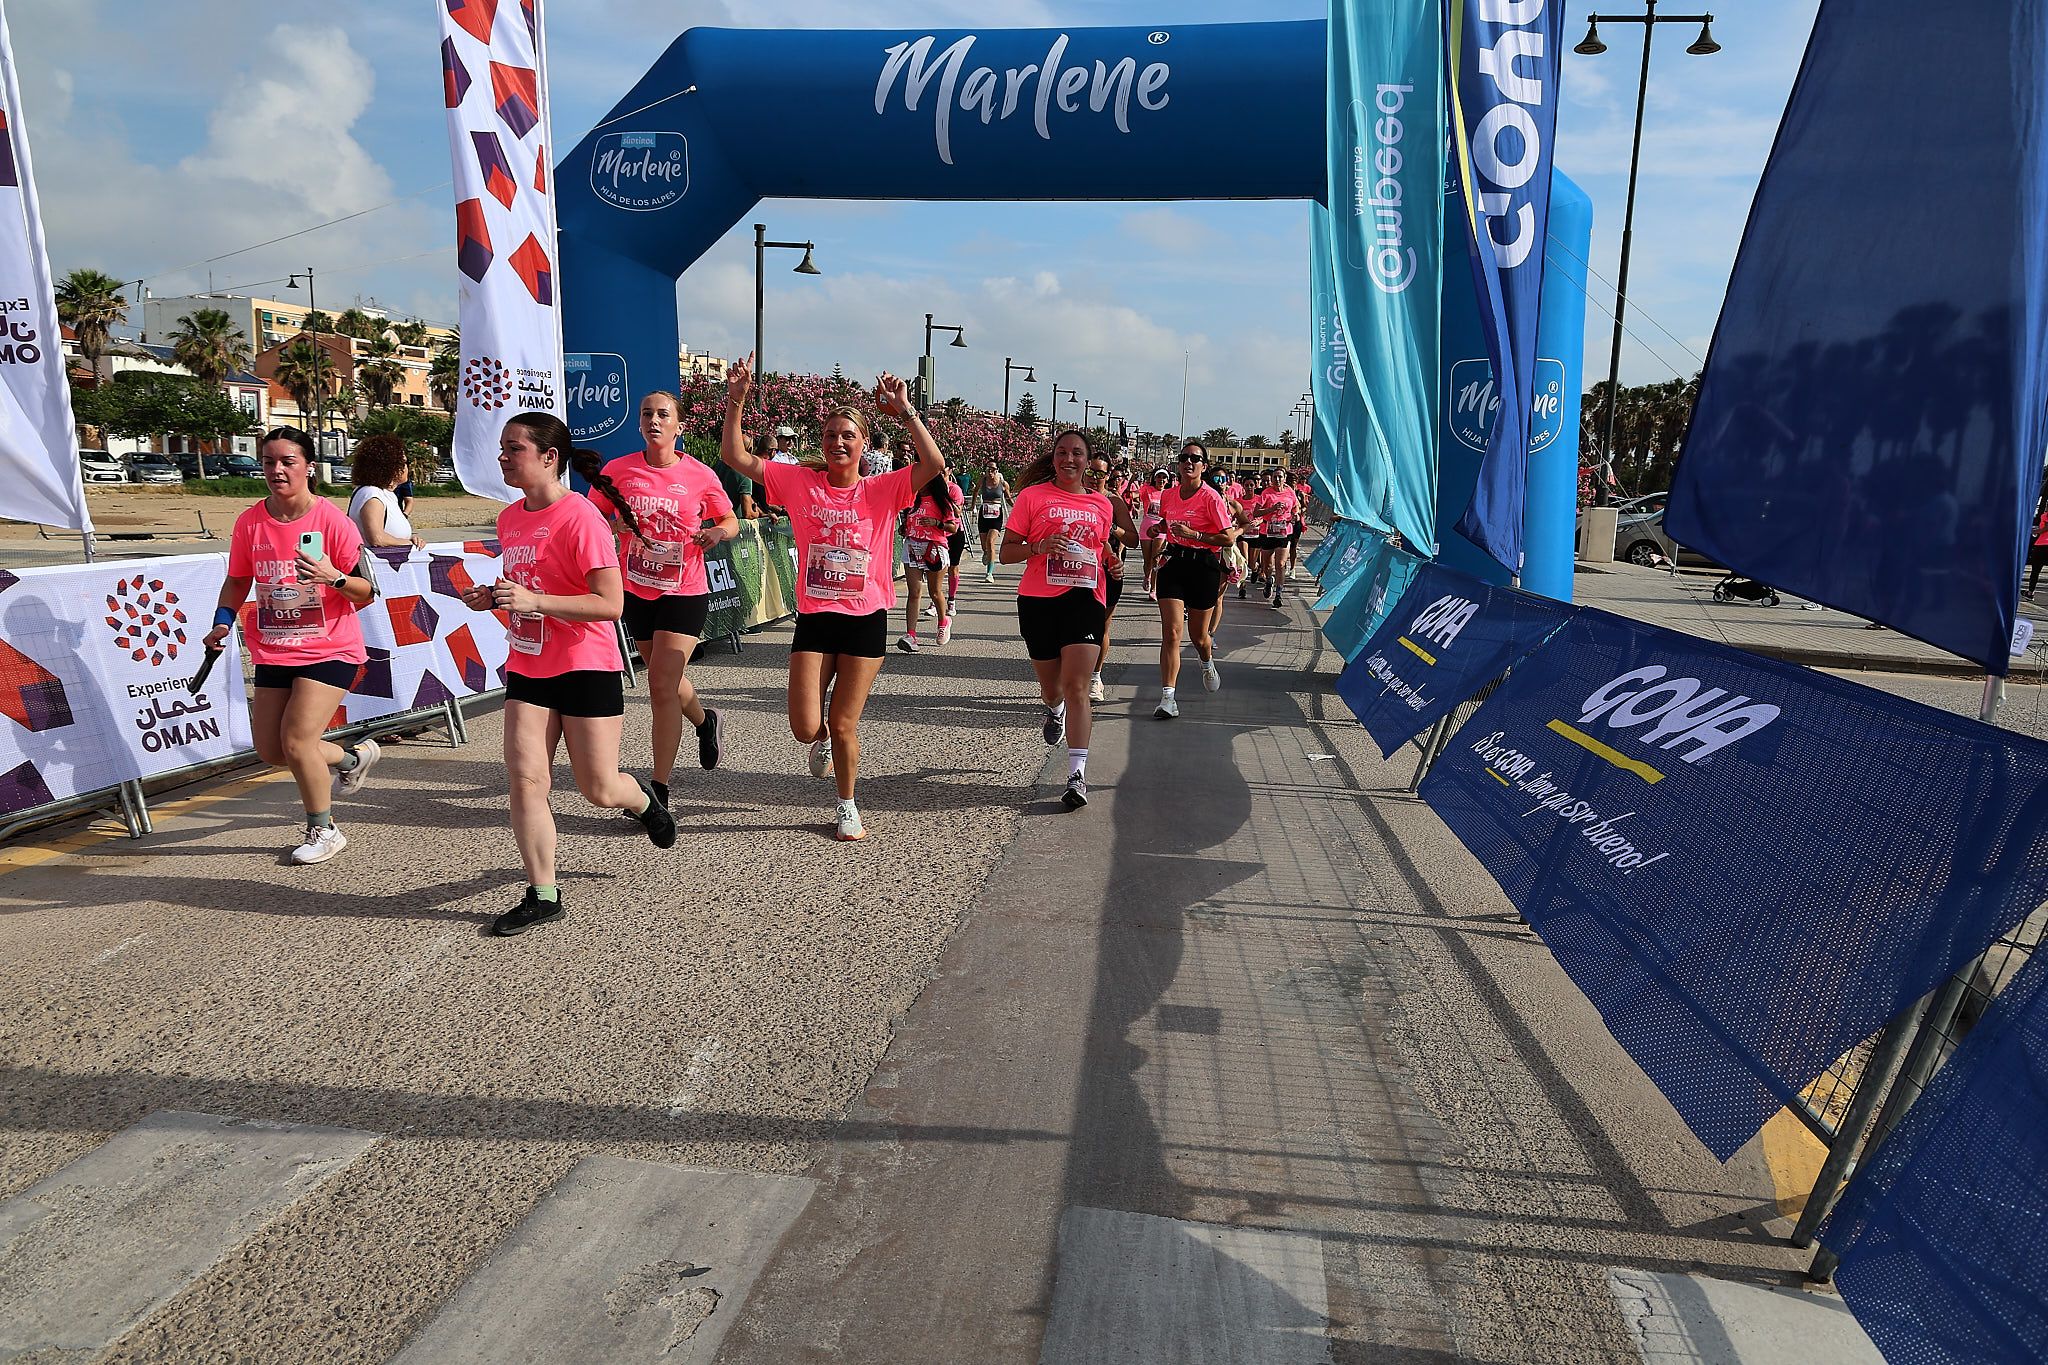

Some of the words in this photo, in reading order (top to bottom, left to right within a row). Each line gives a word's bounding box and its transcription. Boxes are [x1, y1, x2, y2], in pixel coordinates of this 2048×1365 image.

[874, 33, 1170, 166] Marlene
[597, 148, 682, 189] Marlene
[600, 185, 618, 201] HIJA
[619, 196, 631, 205] DE
[651, 190, 676, 206] ALPES
[567, 373, 621, 409] rlene
[1457, 380, 1558, 429] Mane
[588, 416, 615, 434] ALPES
[1462, 427, 1482, 445] HIJA
[1530, 429, 1550, 446] LPES
[628, 496, 679, 515] CARRERA
[811, 504, 859, 524] CARRERA
[1049, 507, 1097, 525] CARRERA
[642, 559, 664, 572] 016
[1063, 560, 1083, 570] 016
[824, 570, 847, 582] 016
[275, 608, 302, 619] 016
[1408, 594, 1480, 650] GOYA
[127, 677, 195, 699] Experien
[1576, 664, 1781, 764] GOYA
[141, 717, 221, 753] OMAN
[1582, 811, 1670, 876] bueno!
